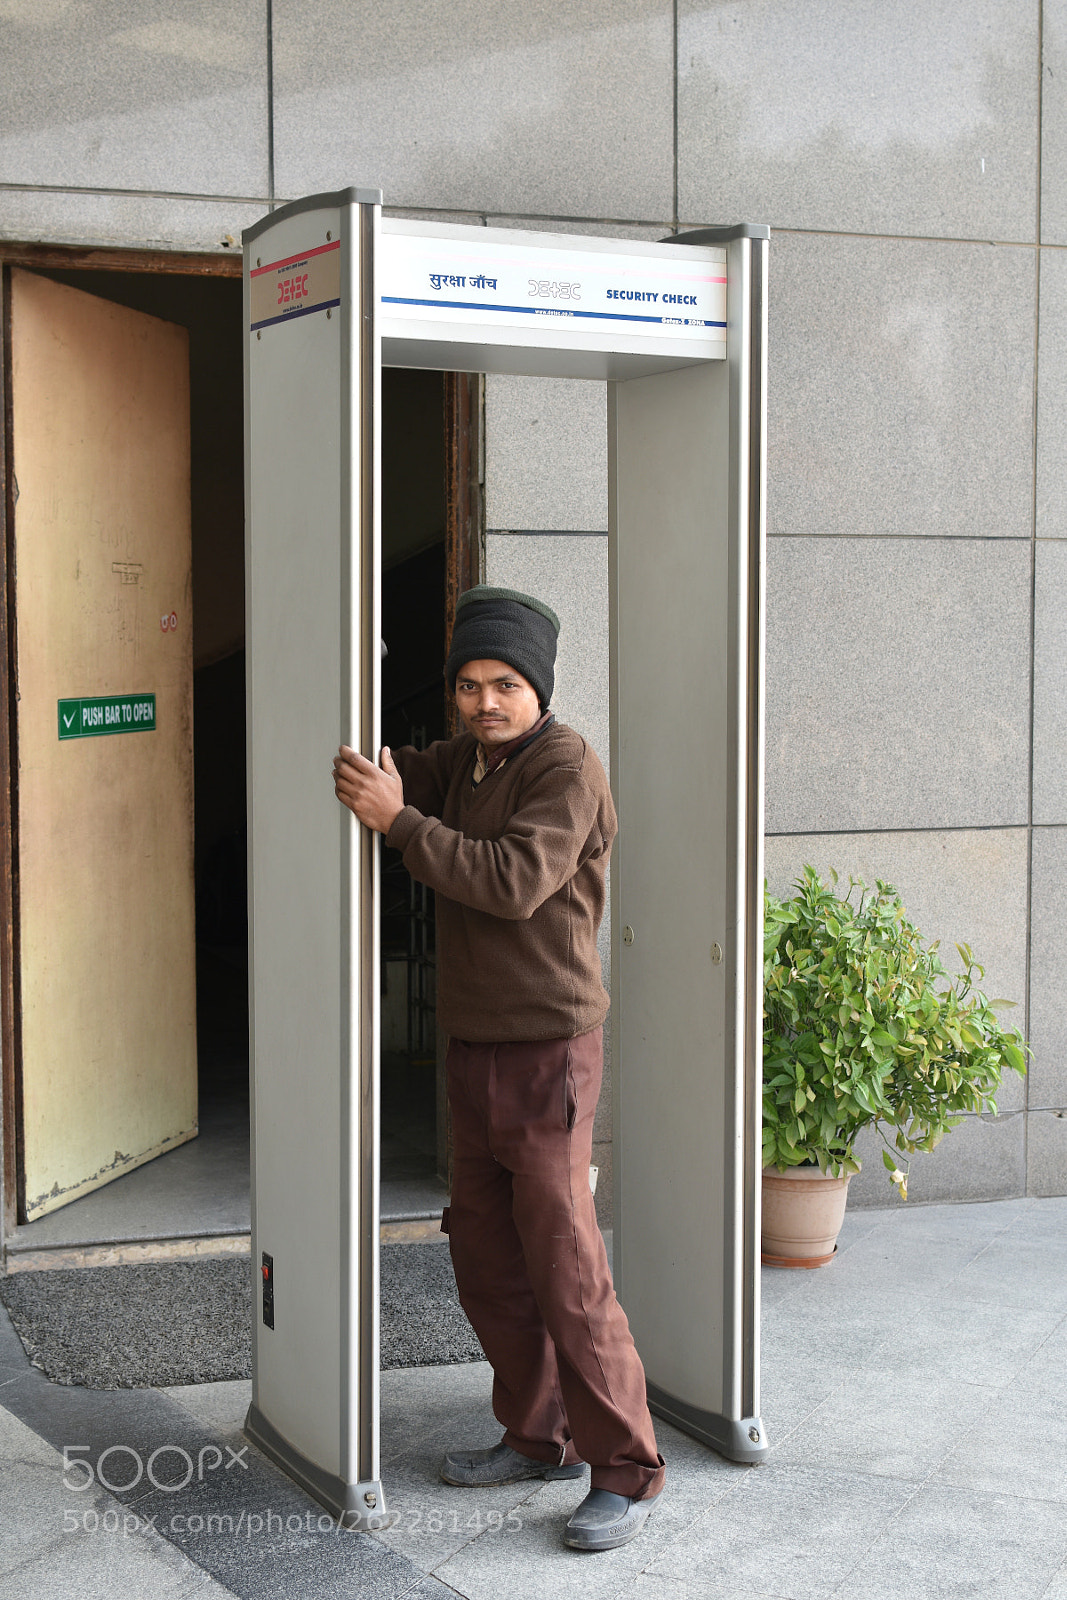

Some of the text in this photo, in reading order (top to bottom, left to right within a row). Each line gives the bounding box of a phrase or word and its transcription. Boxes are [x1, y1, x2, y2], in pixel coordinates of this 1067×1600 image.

[429, 273, 466, 290] सुरक्षा
[606, 289, 698, 306] SECURITY CHECK
[82, 702, 154, 727] PUSH BAR TO OPEN
